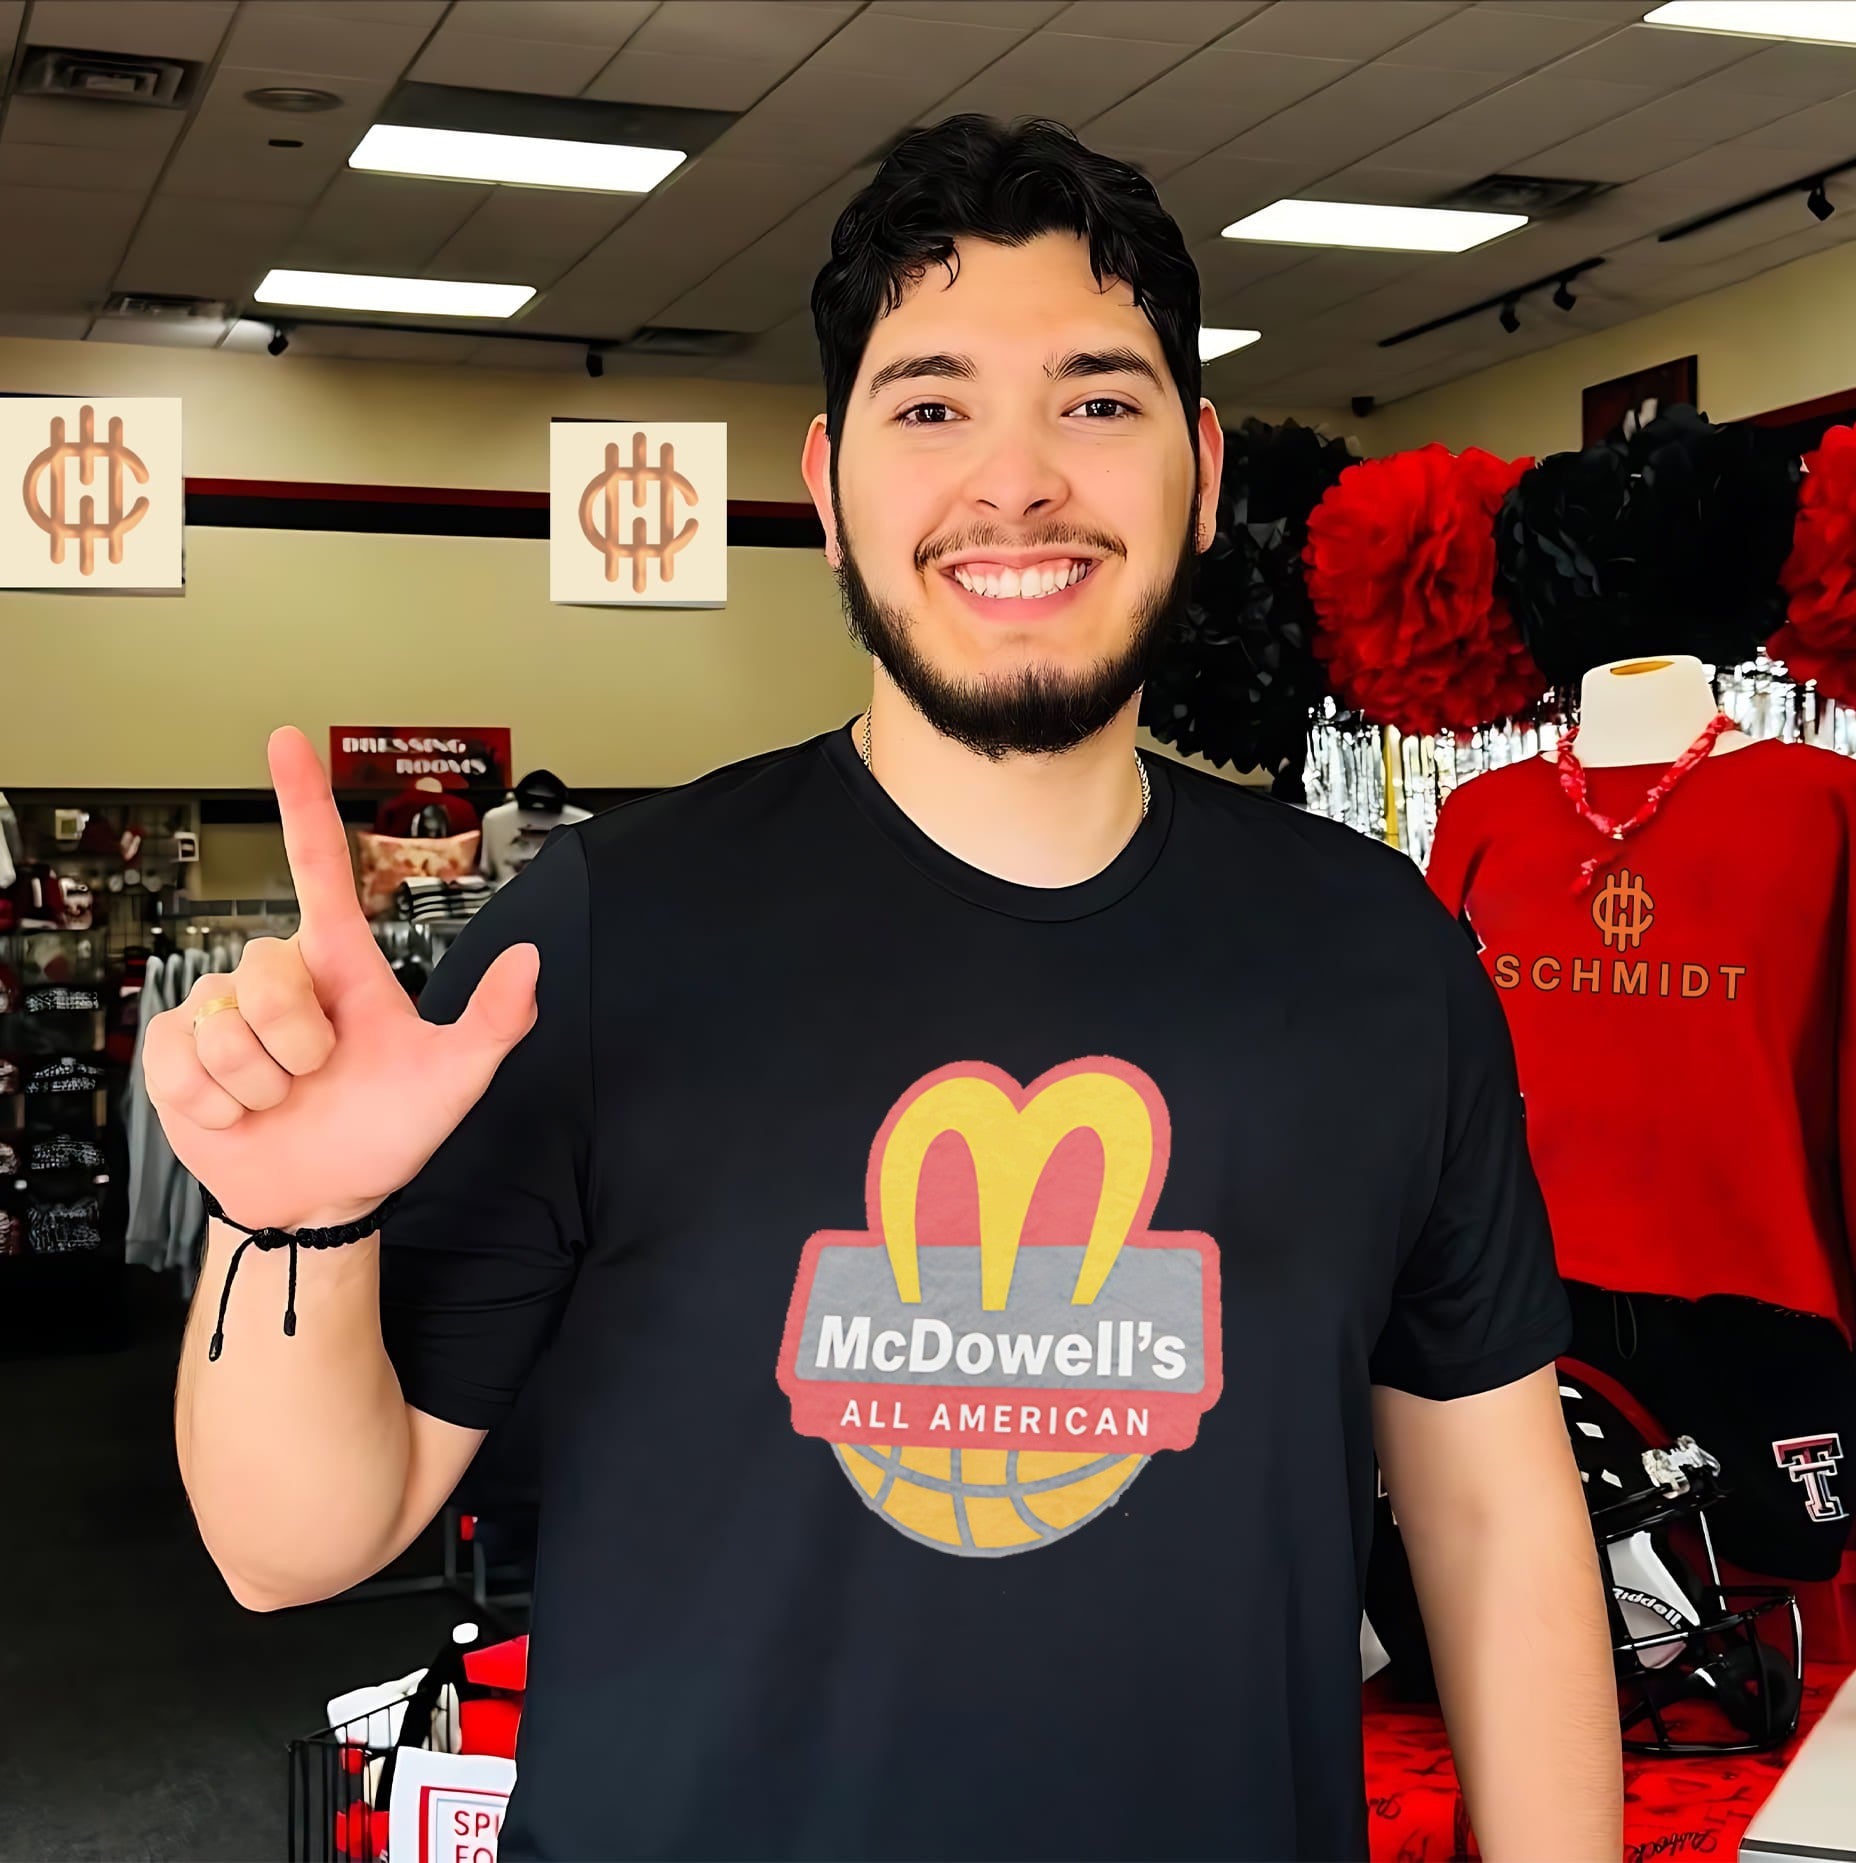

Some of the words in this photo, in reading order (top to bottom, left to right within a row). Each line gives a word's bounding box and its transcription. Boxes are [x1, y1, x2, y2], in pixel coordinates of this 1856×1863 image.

[342, 737, 467, 753] DRESSING
[396, 758, 487, 774] ROOMS
[1494, 954, 1747, 1000] SCHMIDT
[815, 1314, 1187, 1380] McDowell's
[840, 1400, 910, 1430] ALL
[929, 1403, 1150, 1437] AMERICAN
